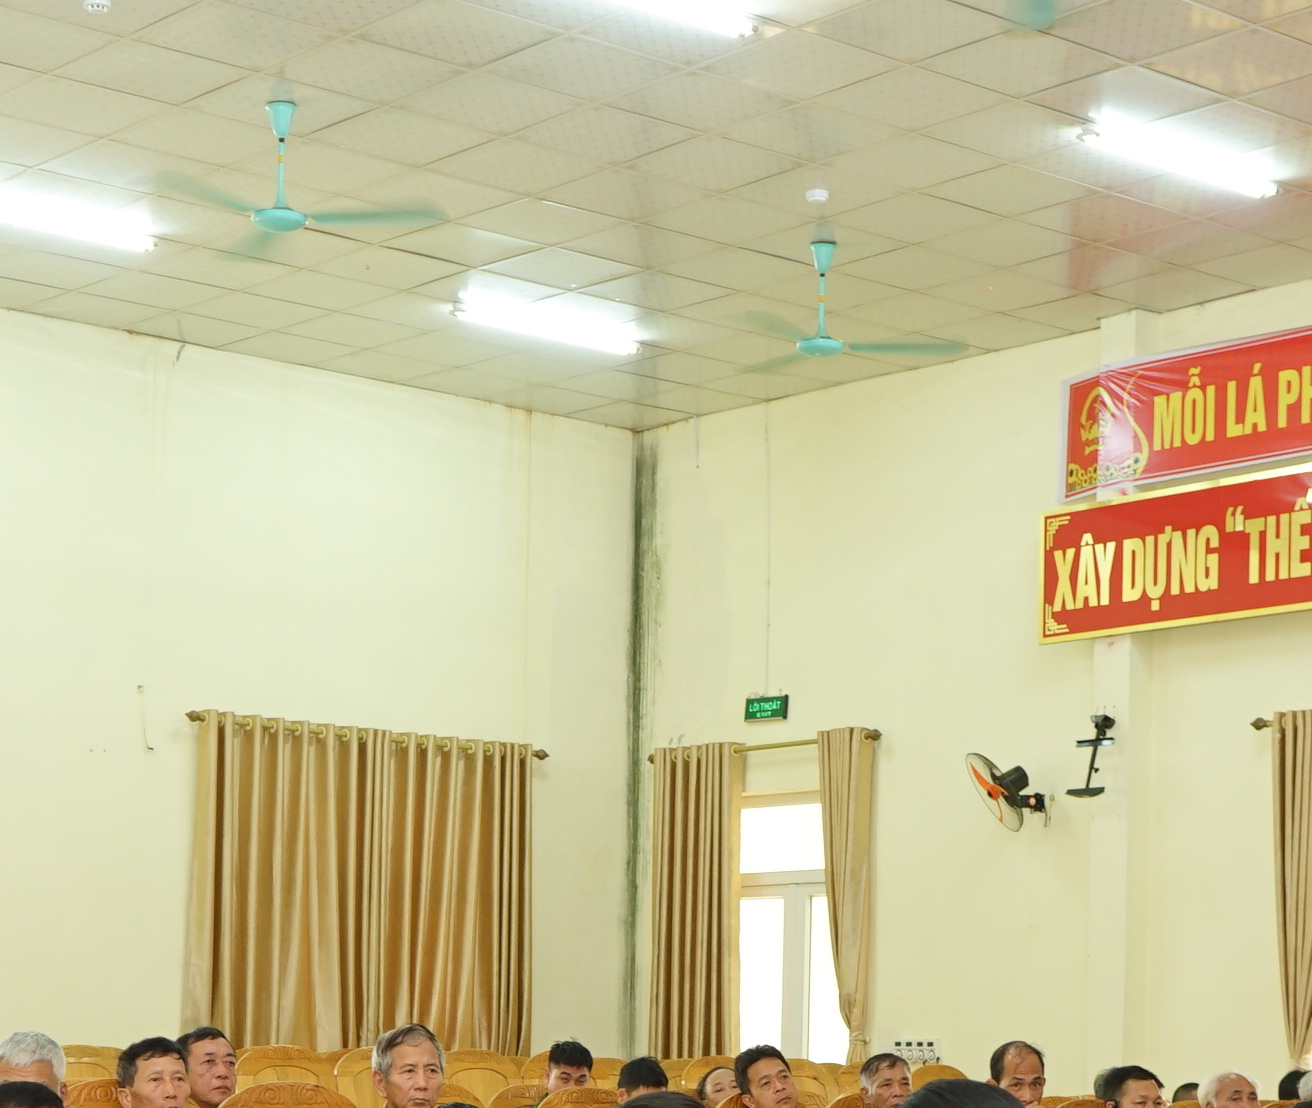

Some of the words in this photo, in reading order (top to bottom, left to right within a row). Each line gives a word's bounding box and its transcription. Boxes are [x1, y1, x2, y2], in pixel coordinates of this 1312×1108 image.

[1152, 366, 1216, 451] MỖI
[1226, 362, 1268, 438] LÁ
[1052, 533, 1116, 612] XÂY
[1122, 525, 1220, 611] DỰNG
